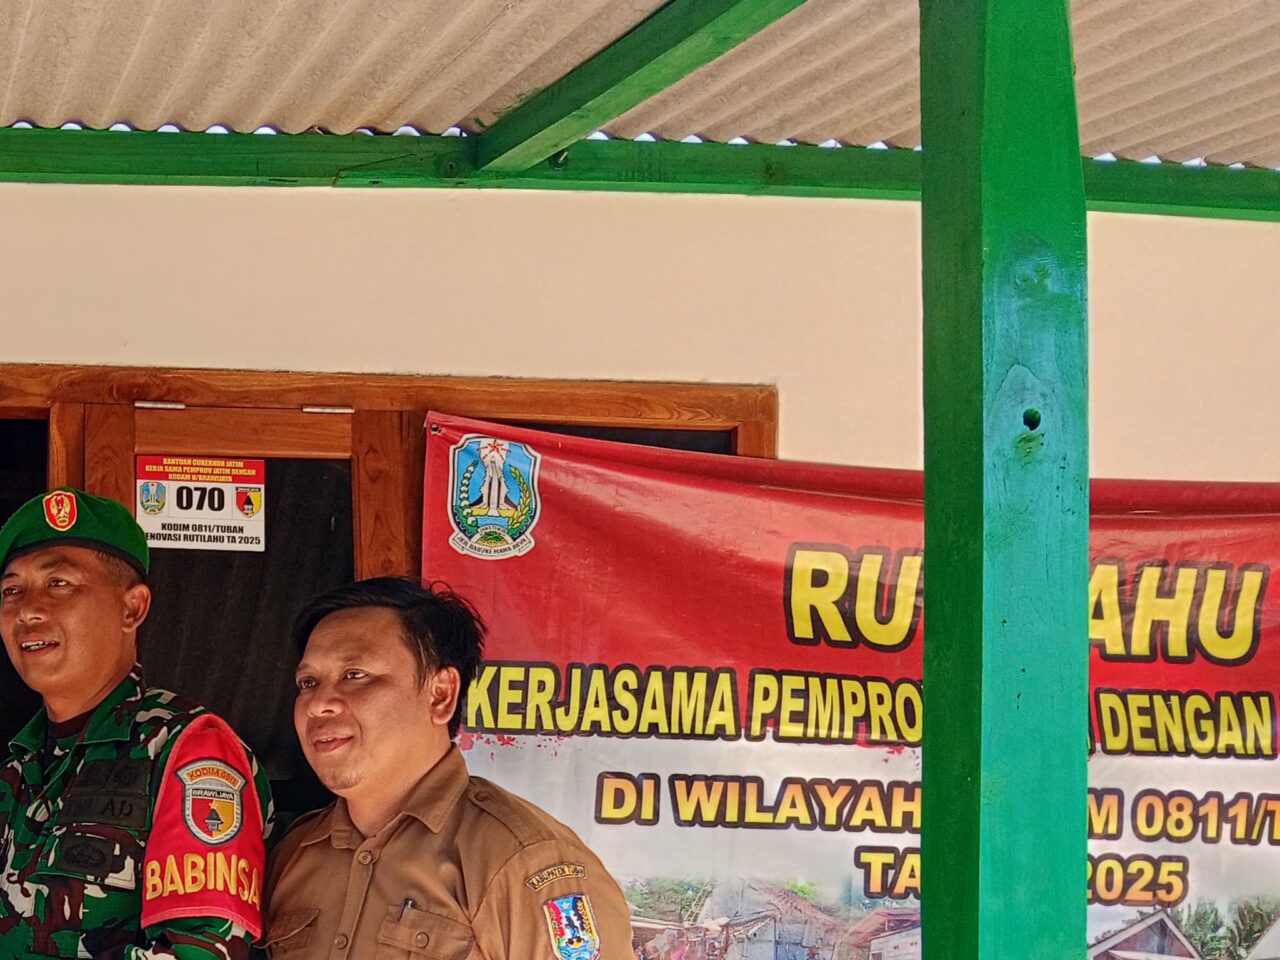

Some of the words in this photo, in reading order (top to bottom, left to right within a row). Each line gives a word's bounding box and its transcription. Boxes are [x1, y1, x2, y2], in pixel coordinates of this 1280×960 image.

[176, 486, 225, 512] 070
[144, 532, 181, 542] ENOVASI
[183, 534, 225, 544] RUTILAHU
[226, 536, 237, 545] TA
[238, 536, 261, 545] 2025
[161, 522, 190, 533] KODIM
[191, 524, 244, 535] 0811/TUBAN
[466, 664, 739, 738] KERJASAMA
[748, 671, 923, 745] PEMPRO
[1096, 691, 1275, 758] DENGAN
[187, 766, 220, 780] KODIM
[598, 775, 658, 822] DI
[672, 777, 921, 830] WILAYAH
[145, 851, 261, 911] BABINSA
[1087, 857, 1186, 904] 025
